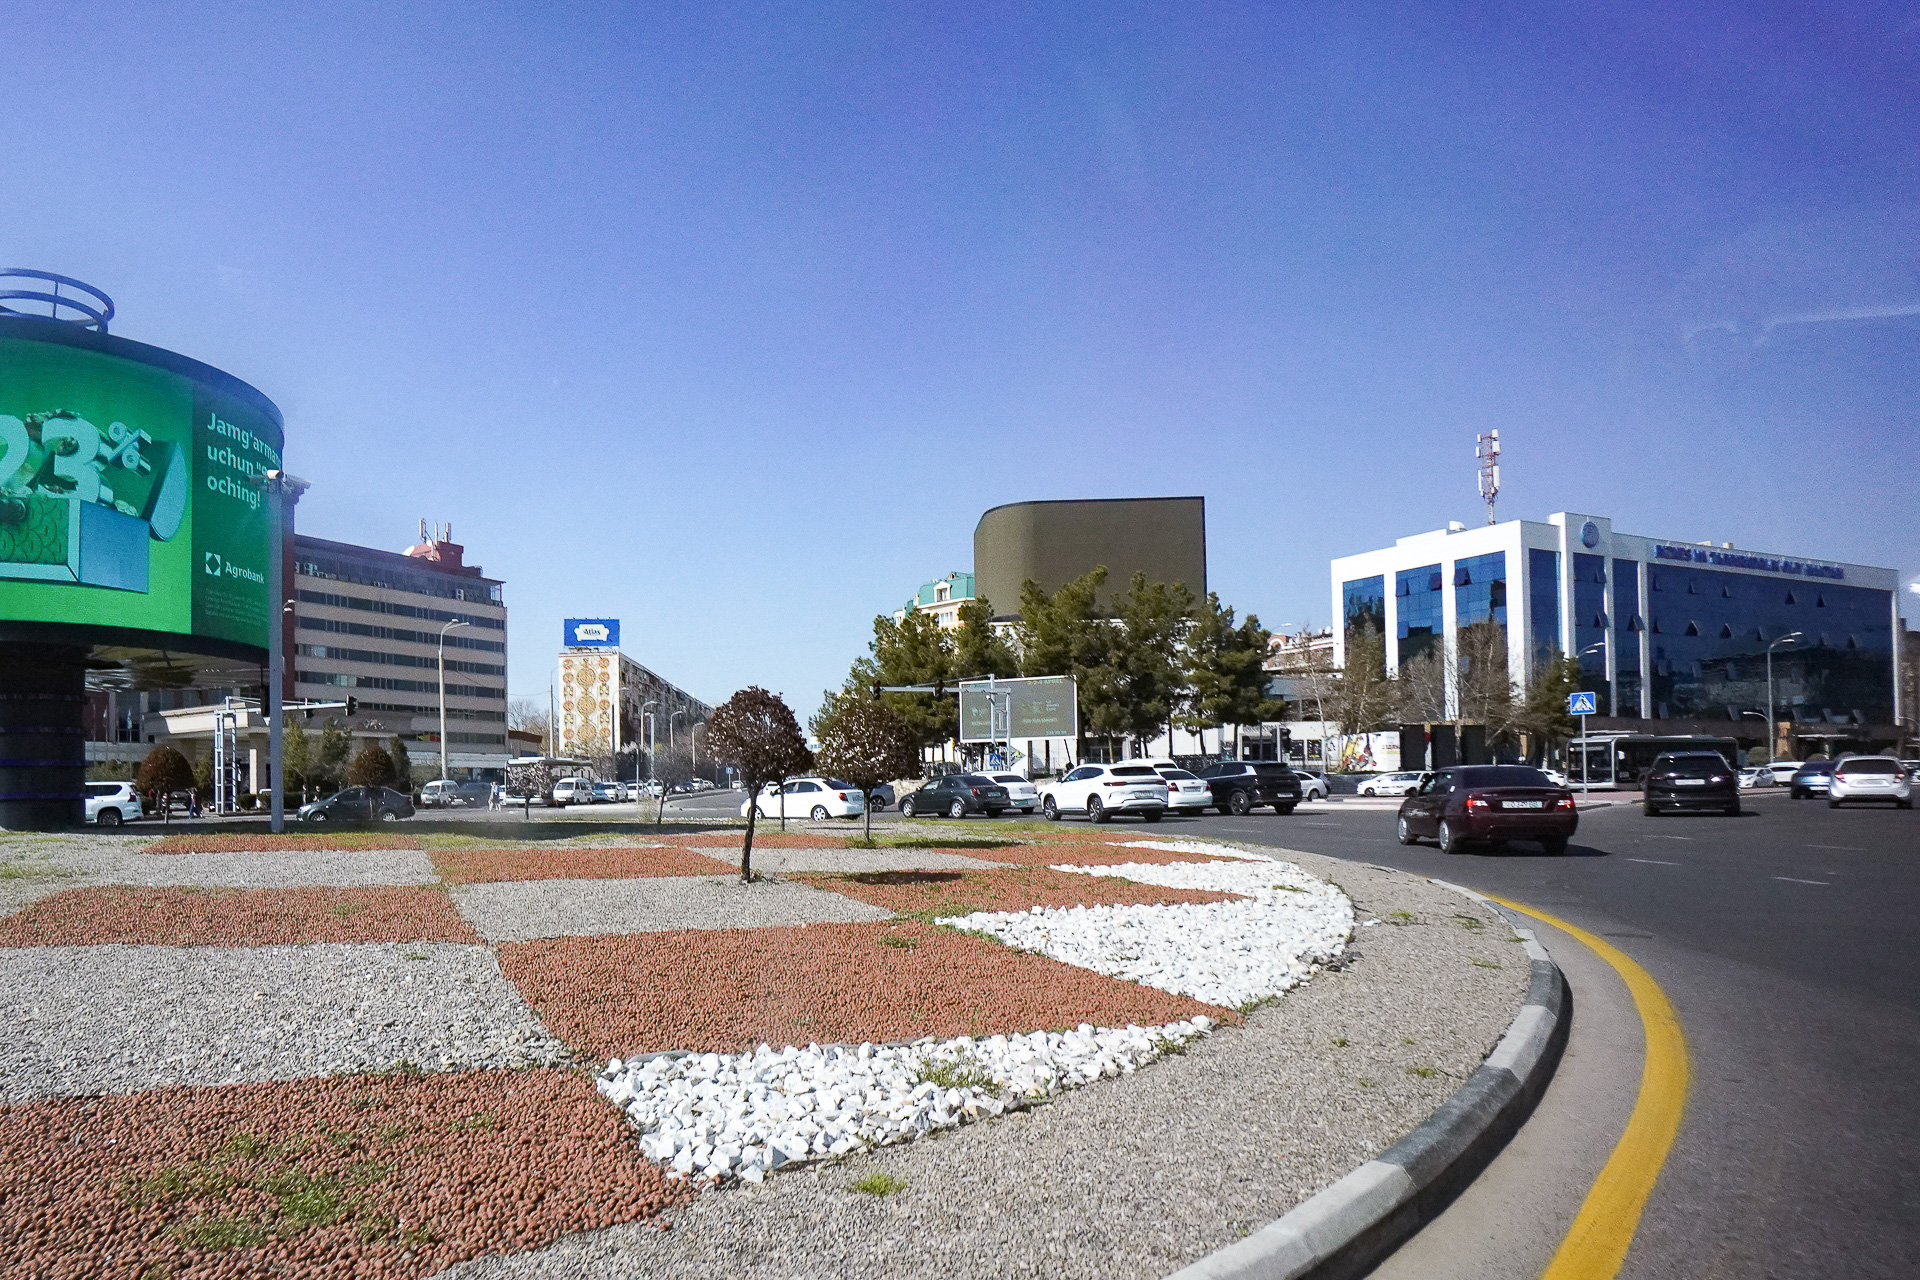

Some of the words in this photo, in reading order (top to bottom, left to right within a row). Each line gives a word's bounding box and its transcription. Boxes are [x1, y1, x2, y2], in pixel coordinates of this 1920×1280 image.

[207, 445, 254, 476] uchun
[207, 475, 260, 510] oching!
[225, 561, 265, 585] Agrobank
